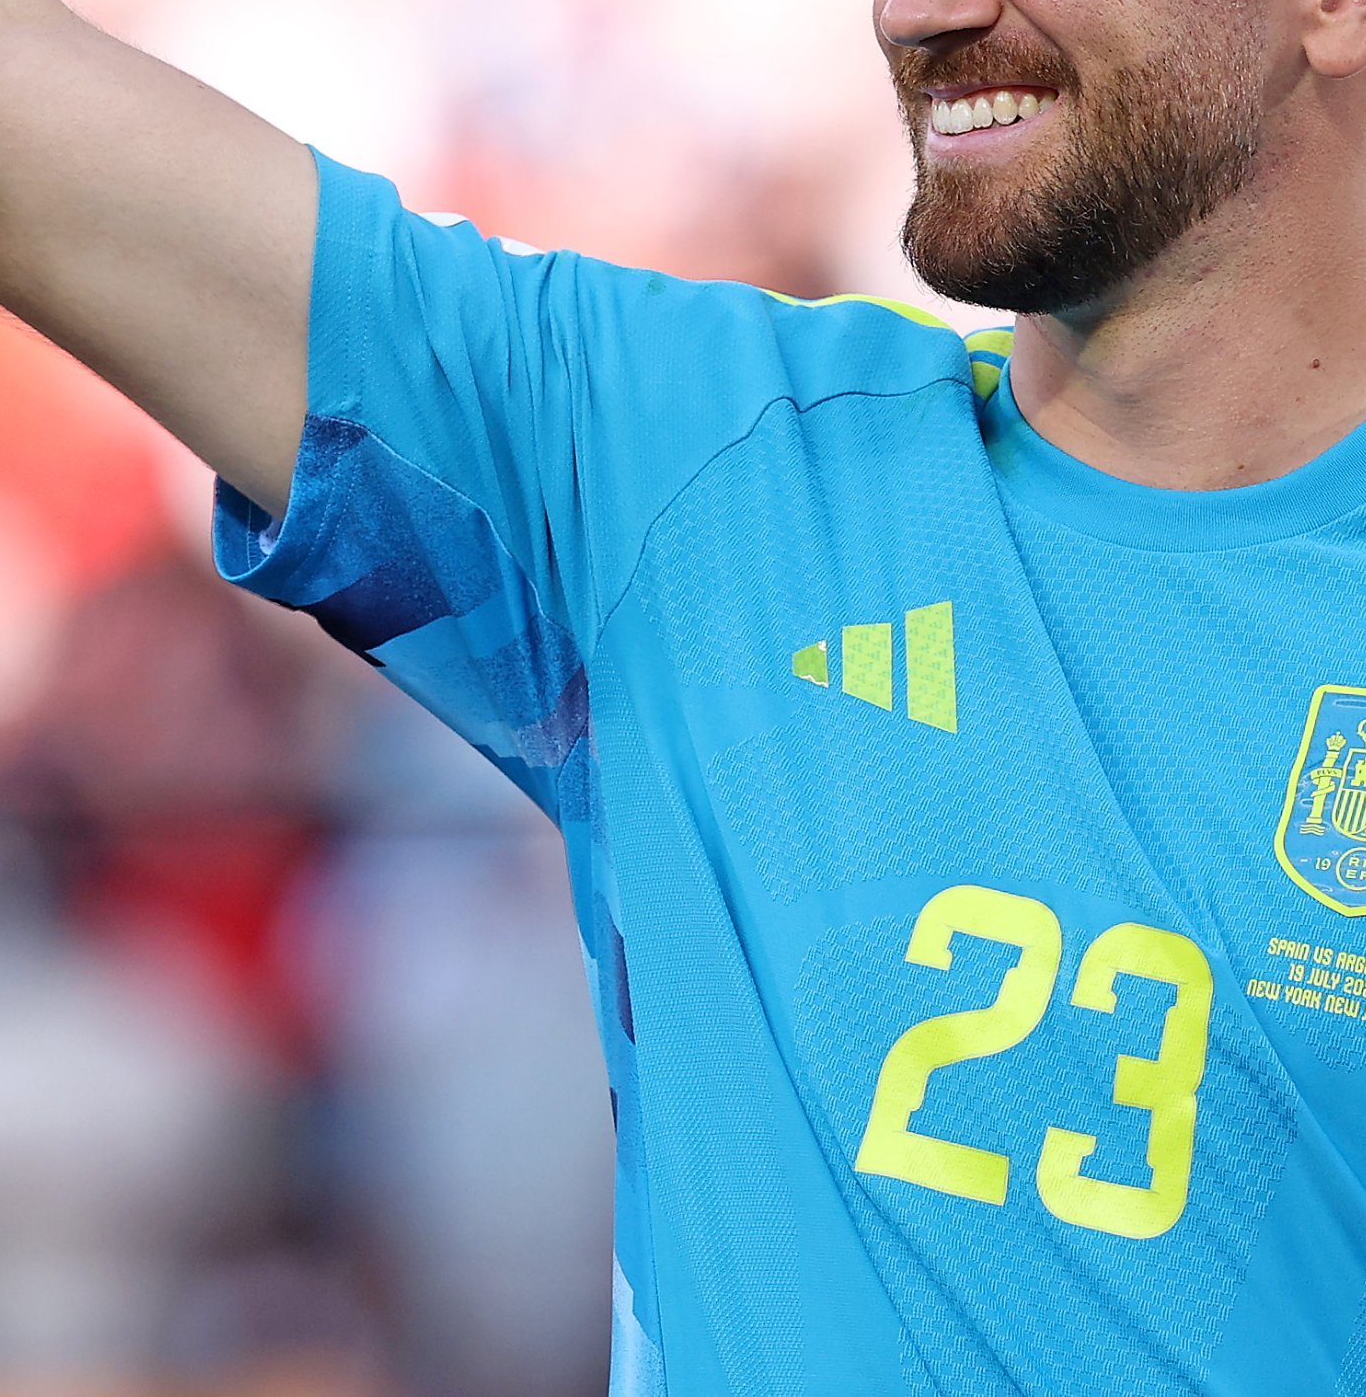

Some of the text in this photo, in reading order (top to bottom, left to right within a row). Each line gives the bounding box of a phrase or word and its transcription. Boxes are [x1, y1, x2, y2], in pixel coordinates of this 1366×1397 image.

[1315, 857, 1331, 870] 19
[1267, 938, 1310, 960] SPAIN
[1288, 963, 1304, 982] 19
[1306, 968, 1340, 990] JULY
[1246, 979, 1282, 1000] NEW
[1284, 986, 1322, 1010] YORK
[1324, 995, 1361, 1018] NEW
[855, 884, 1214, 1239] 23
